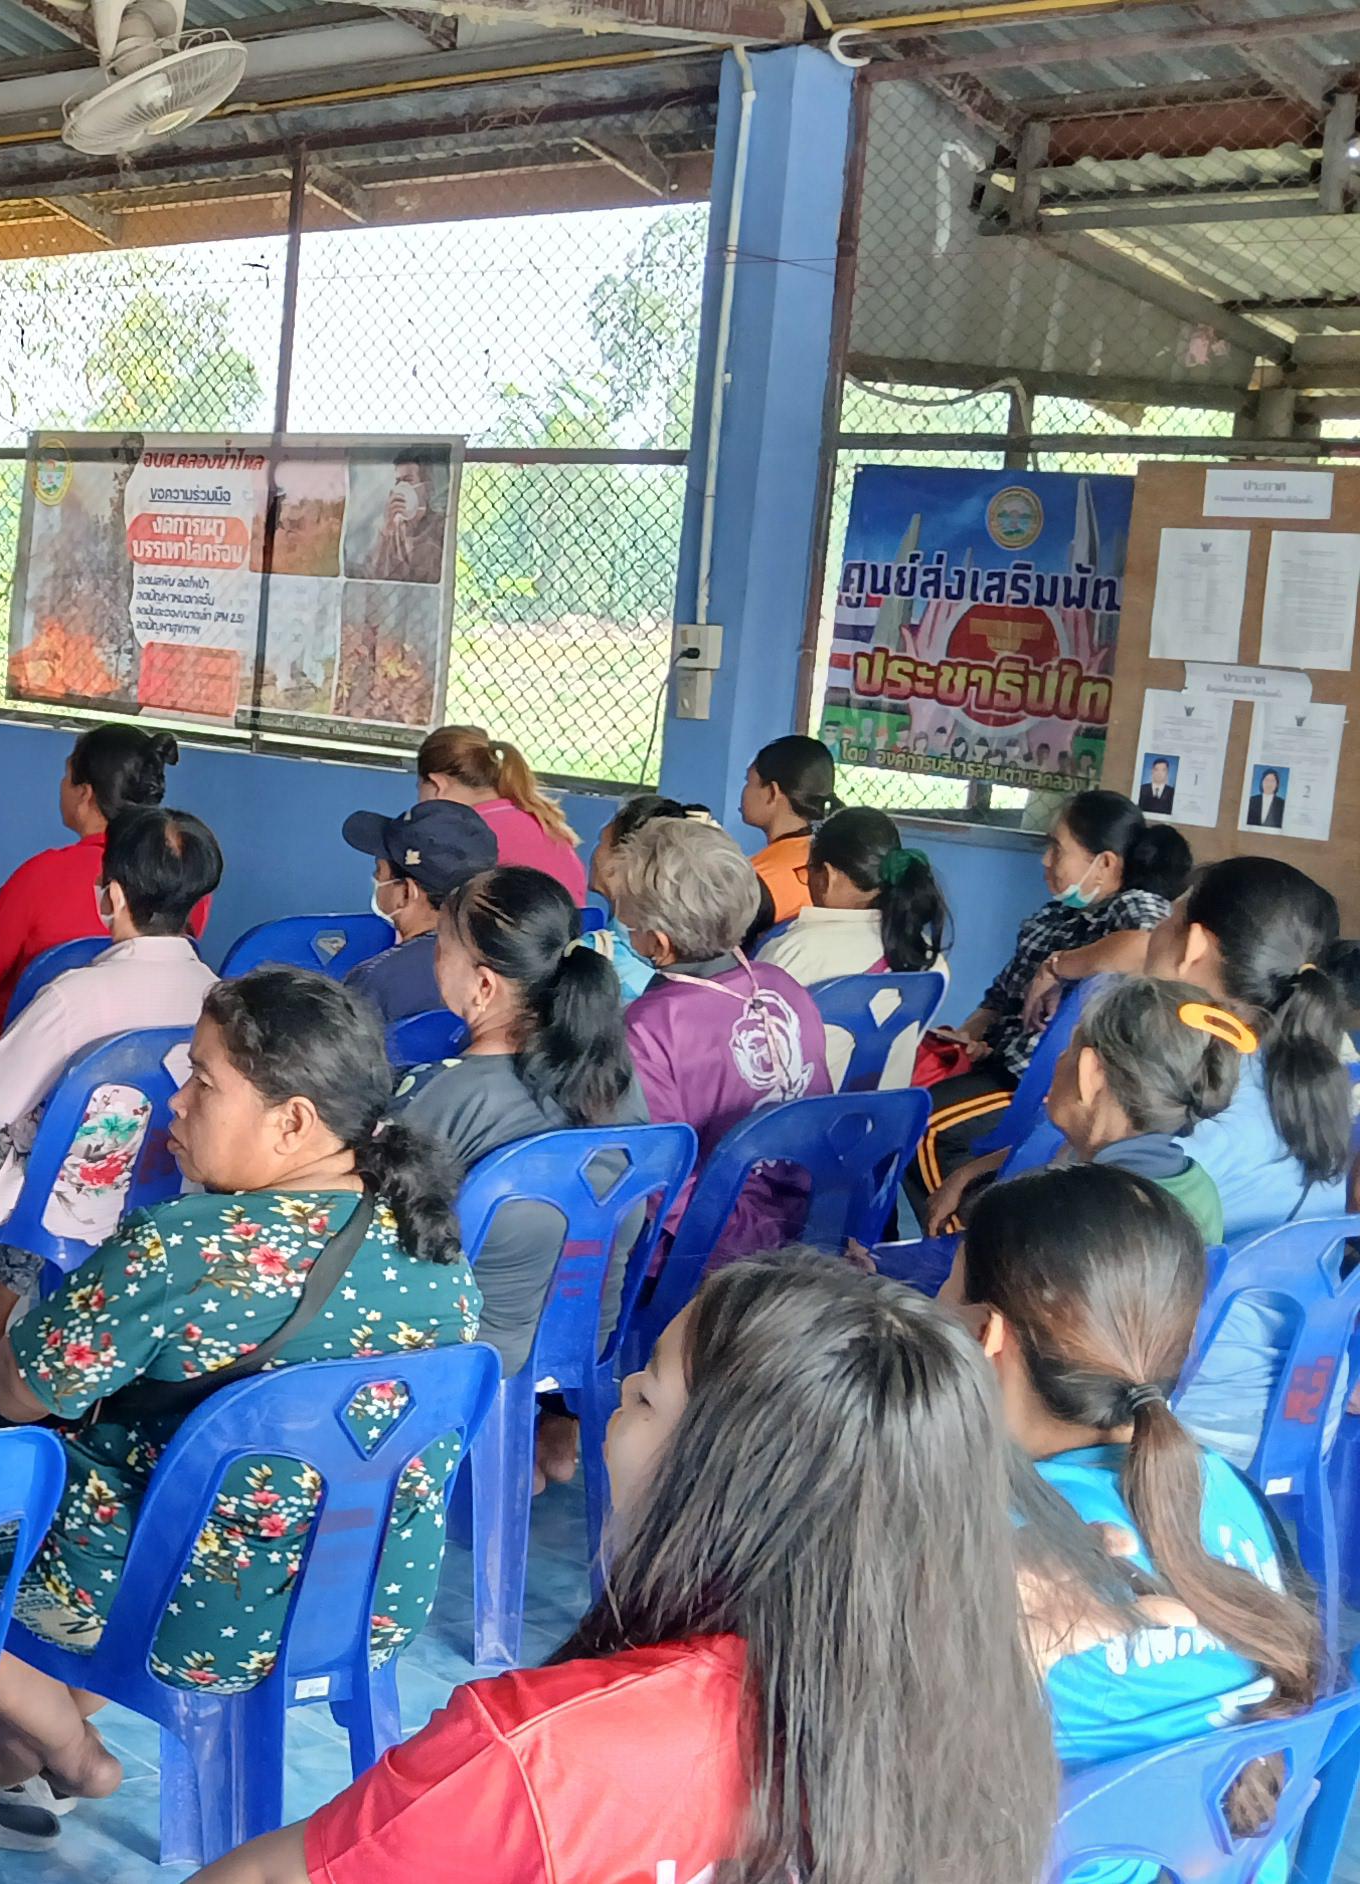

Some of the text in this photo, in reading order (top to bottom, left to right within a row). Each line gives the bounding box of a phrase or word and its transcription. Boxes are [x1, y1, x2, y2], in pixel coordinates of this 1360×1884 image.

[150, 485, 231, 502] ขอความร่วมมือ
[841, 740, 868, 762] โดย
